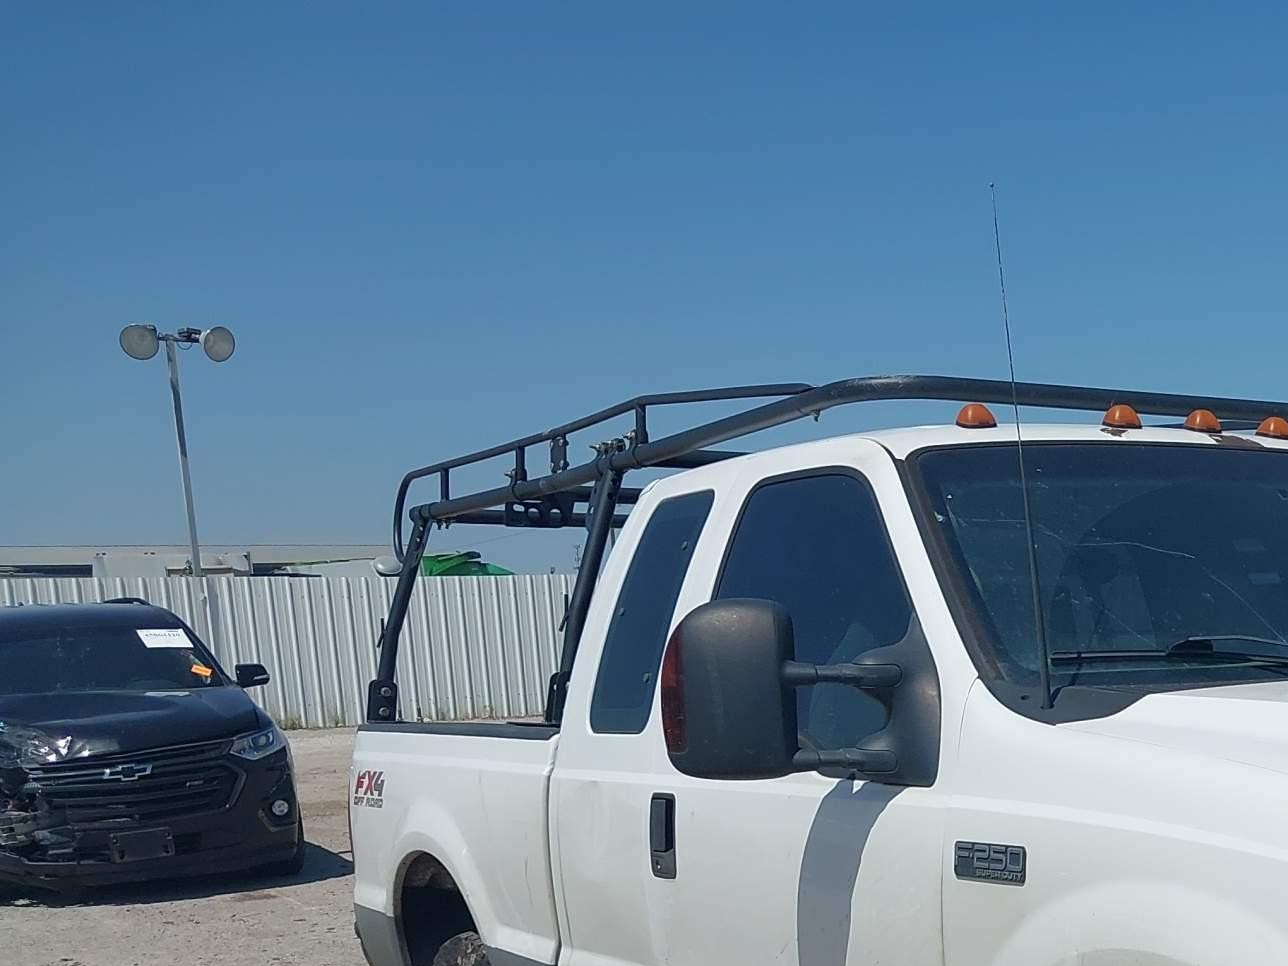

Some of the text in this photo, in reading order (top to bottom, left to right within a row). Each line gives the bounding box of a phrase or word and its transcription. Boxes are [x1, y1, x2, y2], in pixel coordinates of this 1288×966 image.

[355, 770, 385, 797] FX4
[353, 796, 384, 809] OFF ROAD
[975, 868, 1025, 882] SUPER DUTY
